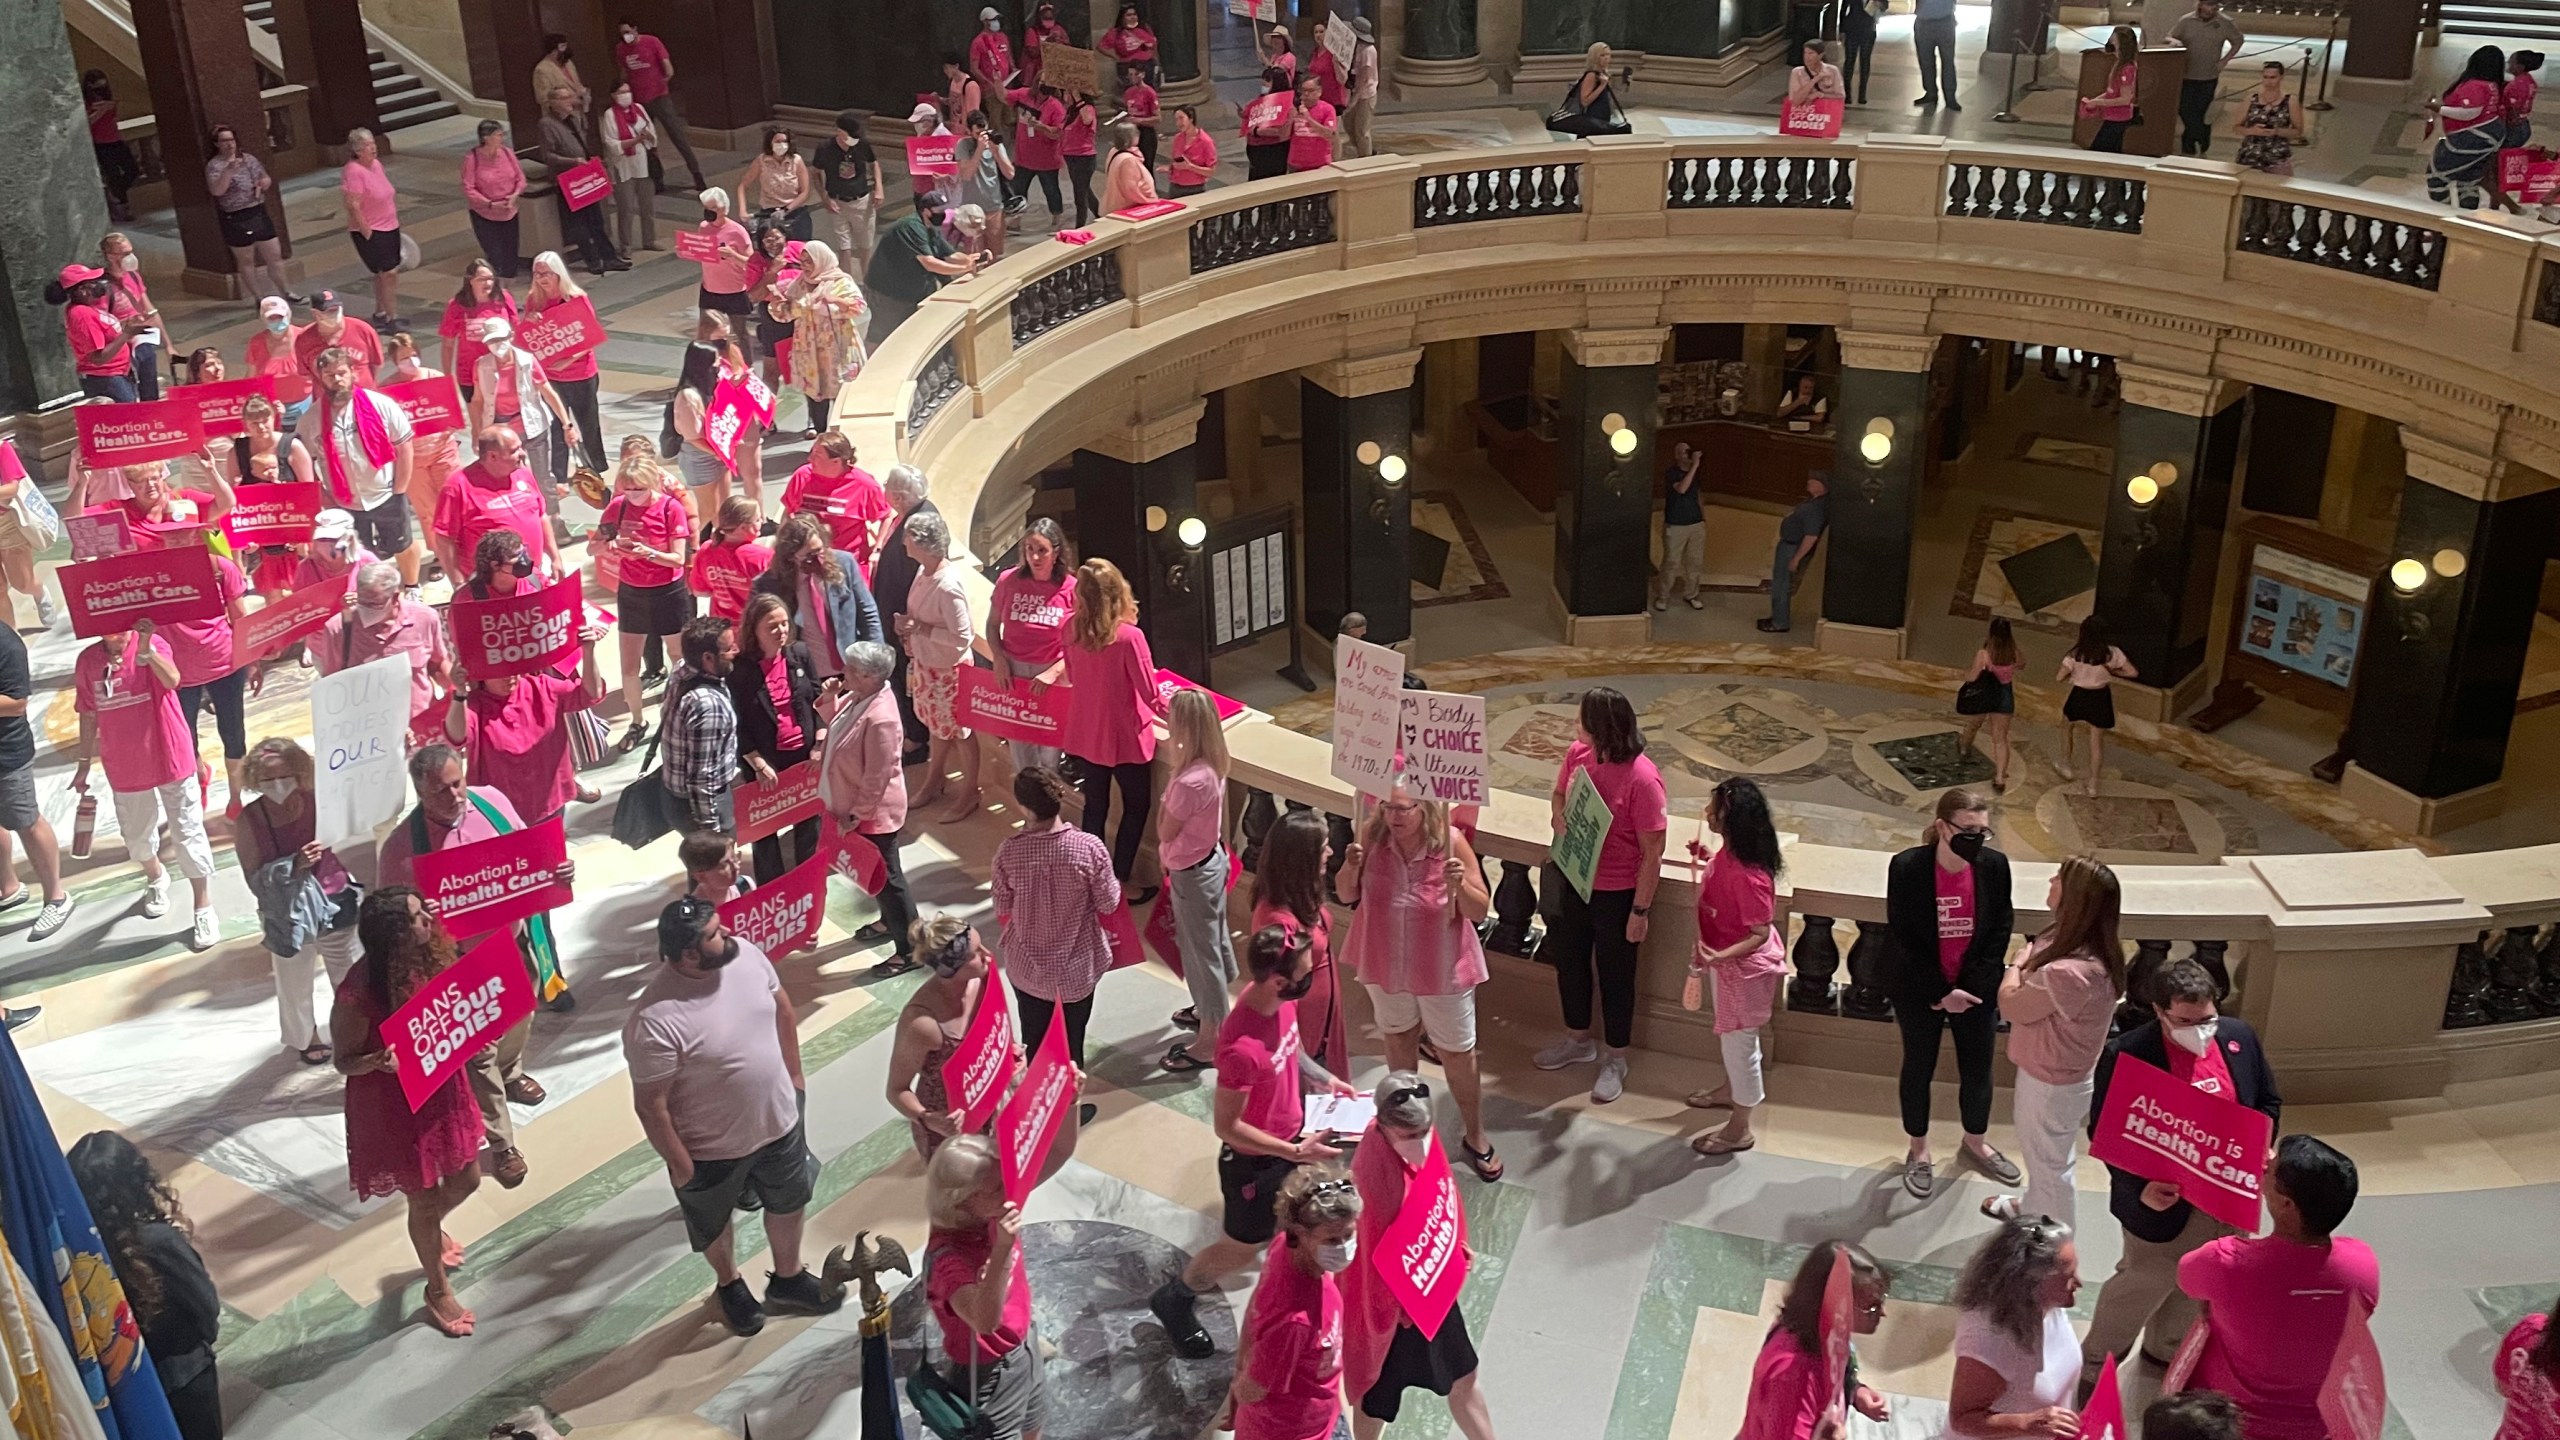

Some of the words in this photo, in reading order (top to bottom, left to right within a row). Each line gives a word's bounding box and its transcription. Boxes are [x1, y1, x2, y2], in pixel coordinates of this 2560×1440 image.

[1788, 120, 1826, 130] BODIES
[1807, 114, 1831, 122] OUR
[916, 154, 944, 162] Health
[522, 320, 558, 342] BANS
[528, 336, 554, 352] OFF
[553, 320, 585, 340] OUR
[534, 332, 585, 361] BODIES
[198, 398, 234, 409] ortion
[202, 407, 228, 418] alth
[416, 406, 448, 418] Care.
[92, 421, 151, 434] Abortion
[154, 419, 165, 430] is
[94, 432, 146, 448] Health
[148, 429, 188, 442] Care.
[230, 502, 283, 516] Abortion
[285, 500, 295, 510] is
[231, 512, 278, 528] Health
[279, 512, 310, 523] Care.
[82, 574, 154, 596] Abortion
[157, 572, 171, 584] is
[86, 588, 148, 612] Health
[152, 584, 199, 600] Care.
[1011, 602, 1036, 614] OFF
[1036, 606, 1064, 618] OUR
[1013, 592, 1046, 606] BANS
[246, 620, 292, 646] Health
[294, 608, 330, 622] Care.
[480, 606, 544, 632] BANS
[482, 626, 529, 648] OFF
[530, 609, 572, 640] OUR
[1010, 612, 1060, 627] BODIES
[486, 628, 568, 665] BODIES
[1346, 649, 1368, 678] My
[326, 667, 390, 715] OUR
[970, 685, 1024, 708] Abortion
[1028, 698, 1038, 710] is
[970, 697, 1016, 718] Health
[1020, 710, 1058, 726] Care.
[1428, 698, 1482, 732] Body
[329, 736, 386, 771] OUR
[1423, 728, 1484, 754] CHOICE
[1424, 753, 1484, 778] Uterus
[748, 782, 804, 812] Abortion
[806, 776, 817, 786] is
[1430, 776, 1482, 802] VOICE
[750, 796, 797, 823] Health
[438, 863, 512, 894] Abortion
[516, 857, 528, 871] is
[440, 882, 504, 912] Health
[507, 869, 554, 891] Care.
[734, 892, 786, 932] BANS
[774, 892, 814, 930] OUR
[756, 914, 808, 954] ODIES
[408, 982, 462, 1040] BANS
[414, 1012, 452, 1057] OFF
[452, 976, 506, 1022] OUR
[420, 1000, 502, 1078] BODIES
[962, 1026, 998, 1089] Abortion
[964, 1048, 1000, 1104] Health
[1014, 1078, 1048, 1150] Abortion
[2129, 1095, 2220, 1150] Abortion
[2225, 1138, 2244, 1160] is
[1016, 1105, 1046, 1170] Health
[2125, 1113, 2201, 1165] Health
[2205, 1156, 2260, 1190] Care.
[1402, 1195, 1445, 1276] Abortion
[1411, 1220, 1454, 1290] Health
